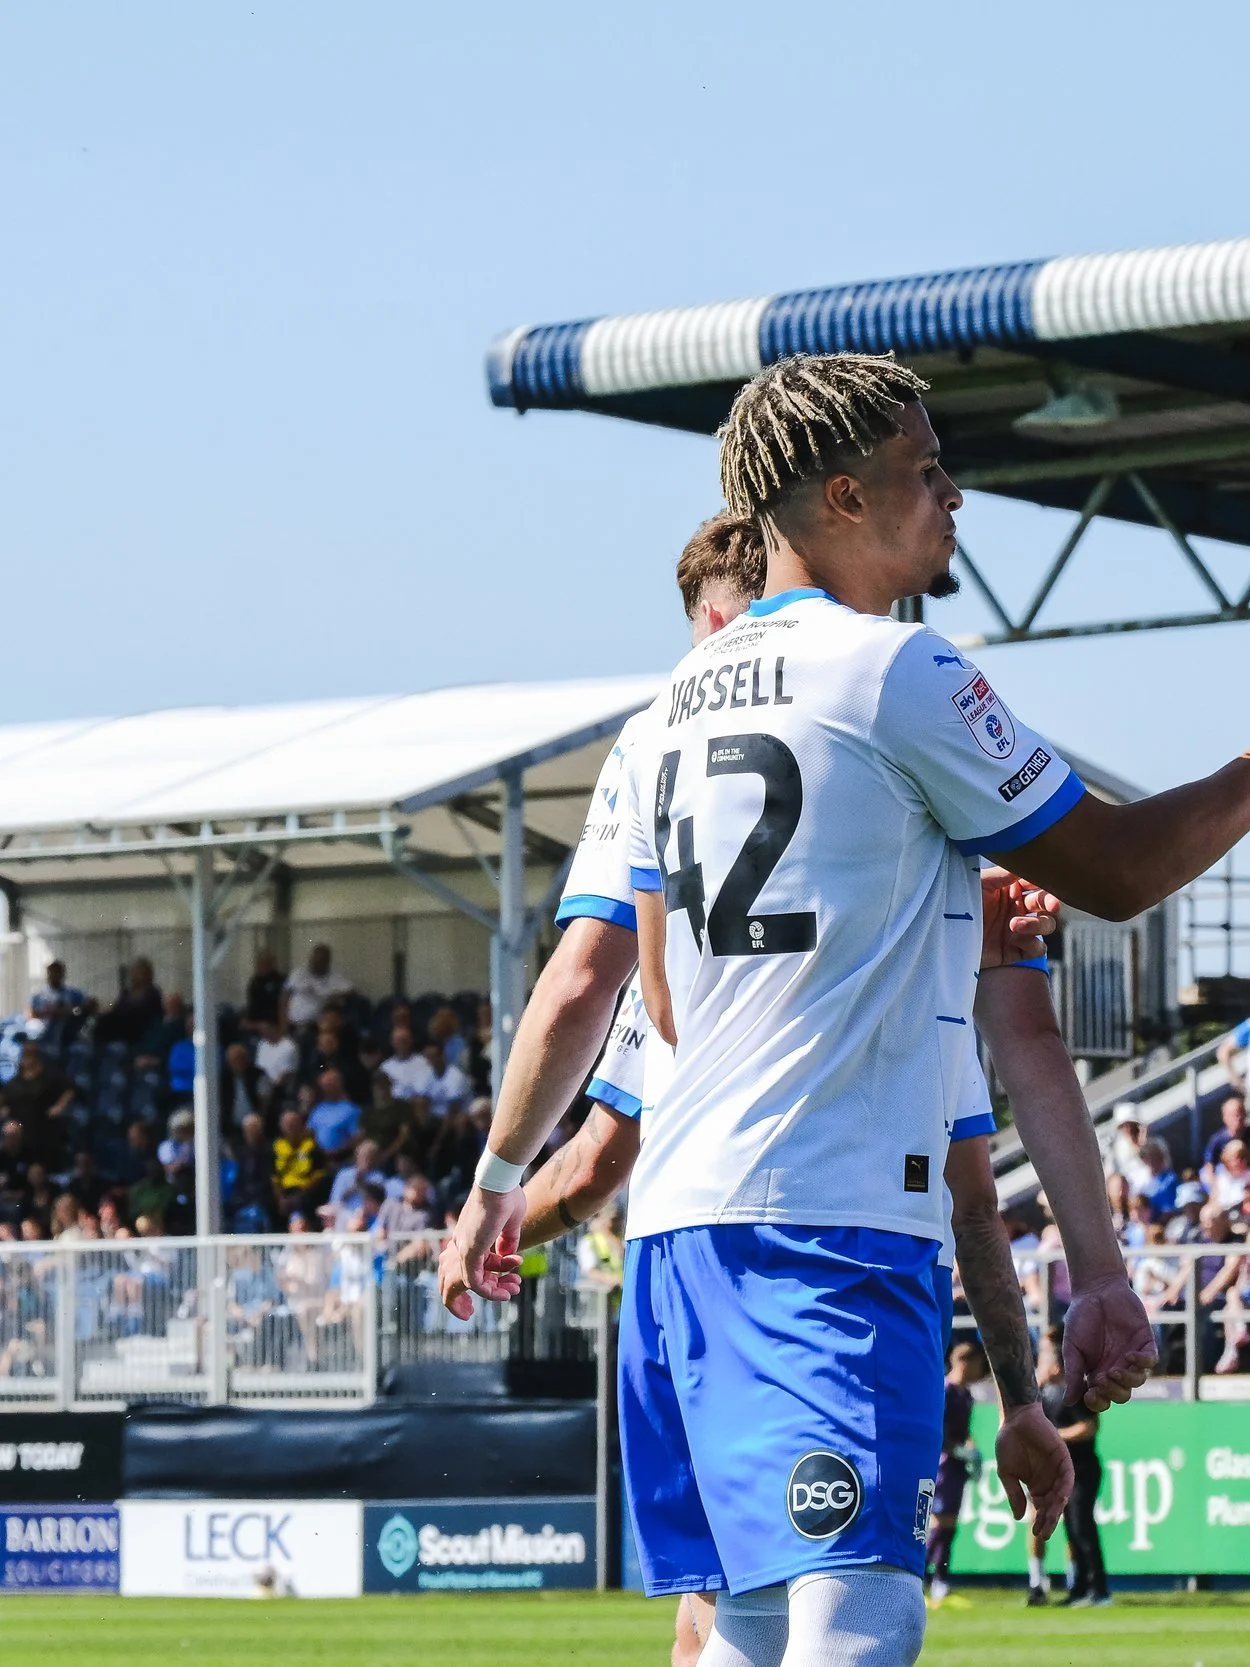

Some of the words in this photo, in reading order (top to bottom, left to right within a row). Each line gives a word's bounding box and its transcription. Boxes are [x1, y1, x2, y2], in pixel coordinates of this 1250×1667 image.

[667, 656, 794, 728] VASSELL
[959, 691, 976, 711] sky
[973, 678, 988, 697] bet
[966, 703, 987, 722] LEAGUE
[995, 736, 1010, 752] EFL
[654, 733, 817, 957] 42
[751, 940, 765, 949] EFL
[18, 1441, 85, 1471] TODAY
[792, 1480, 855, 1512] DSG
[6, 1516, 118, 1553] BARRON
[184, 1512, 293, 1562] LECK
